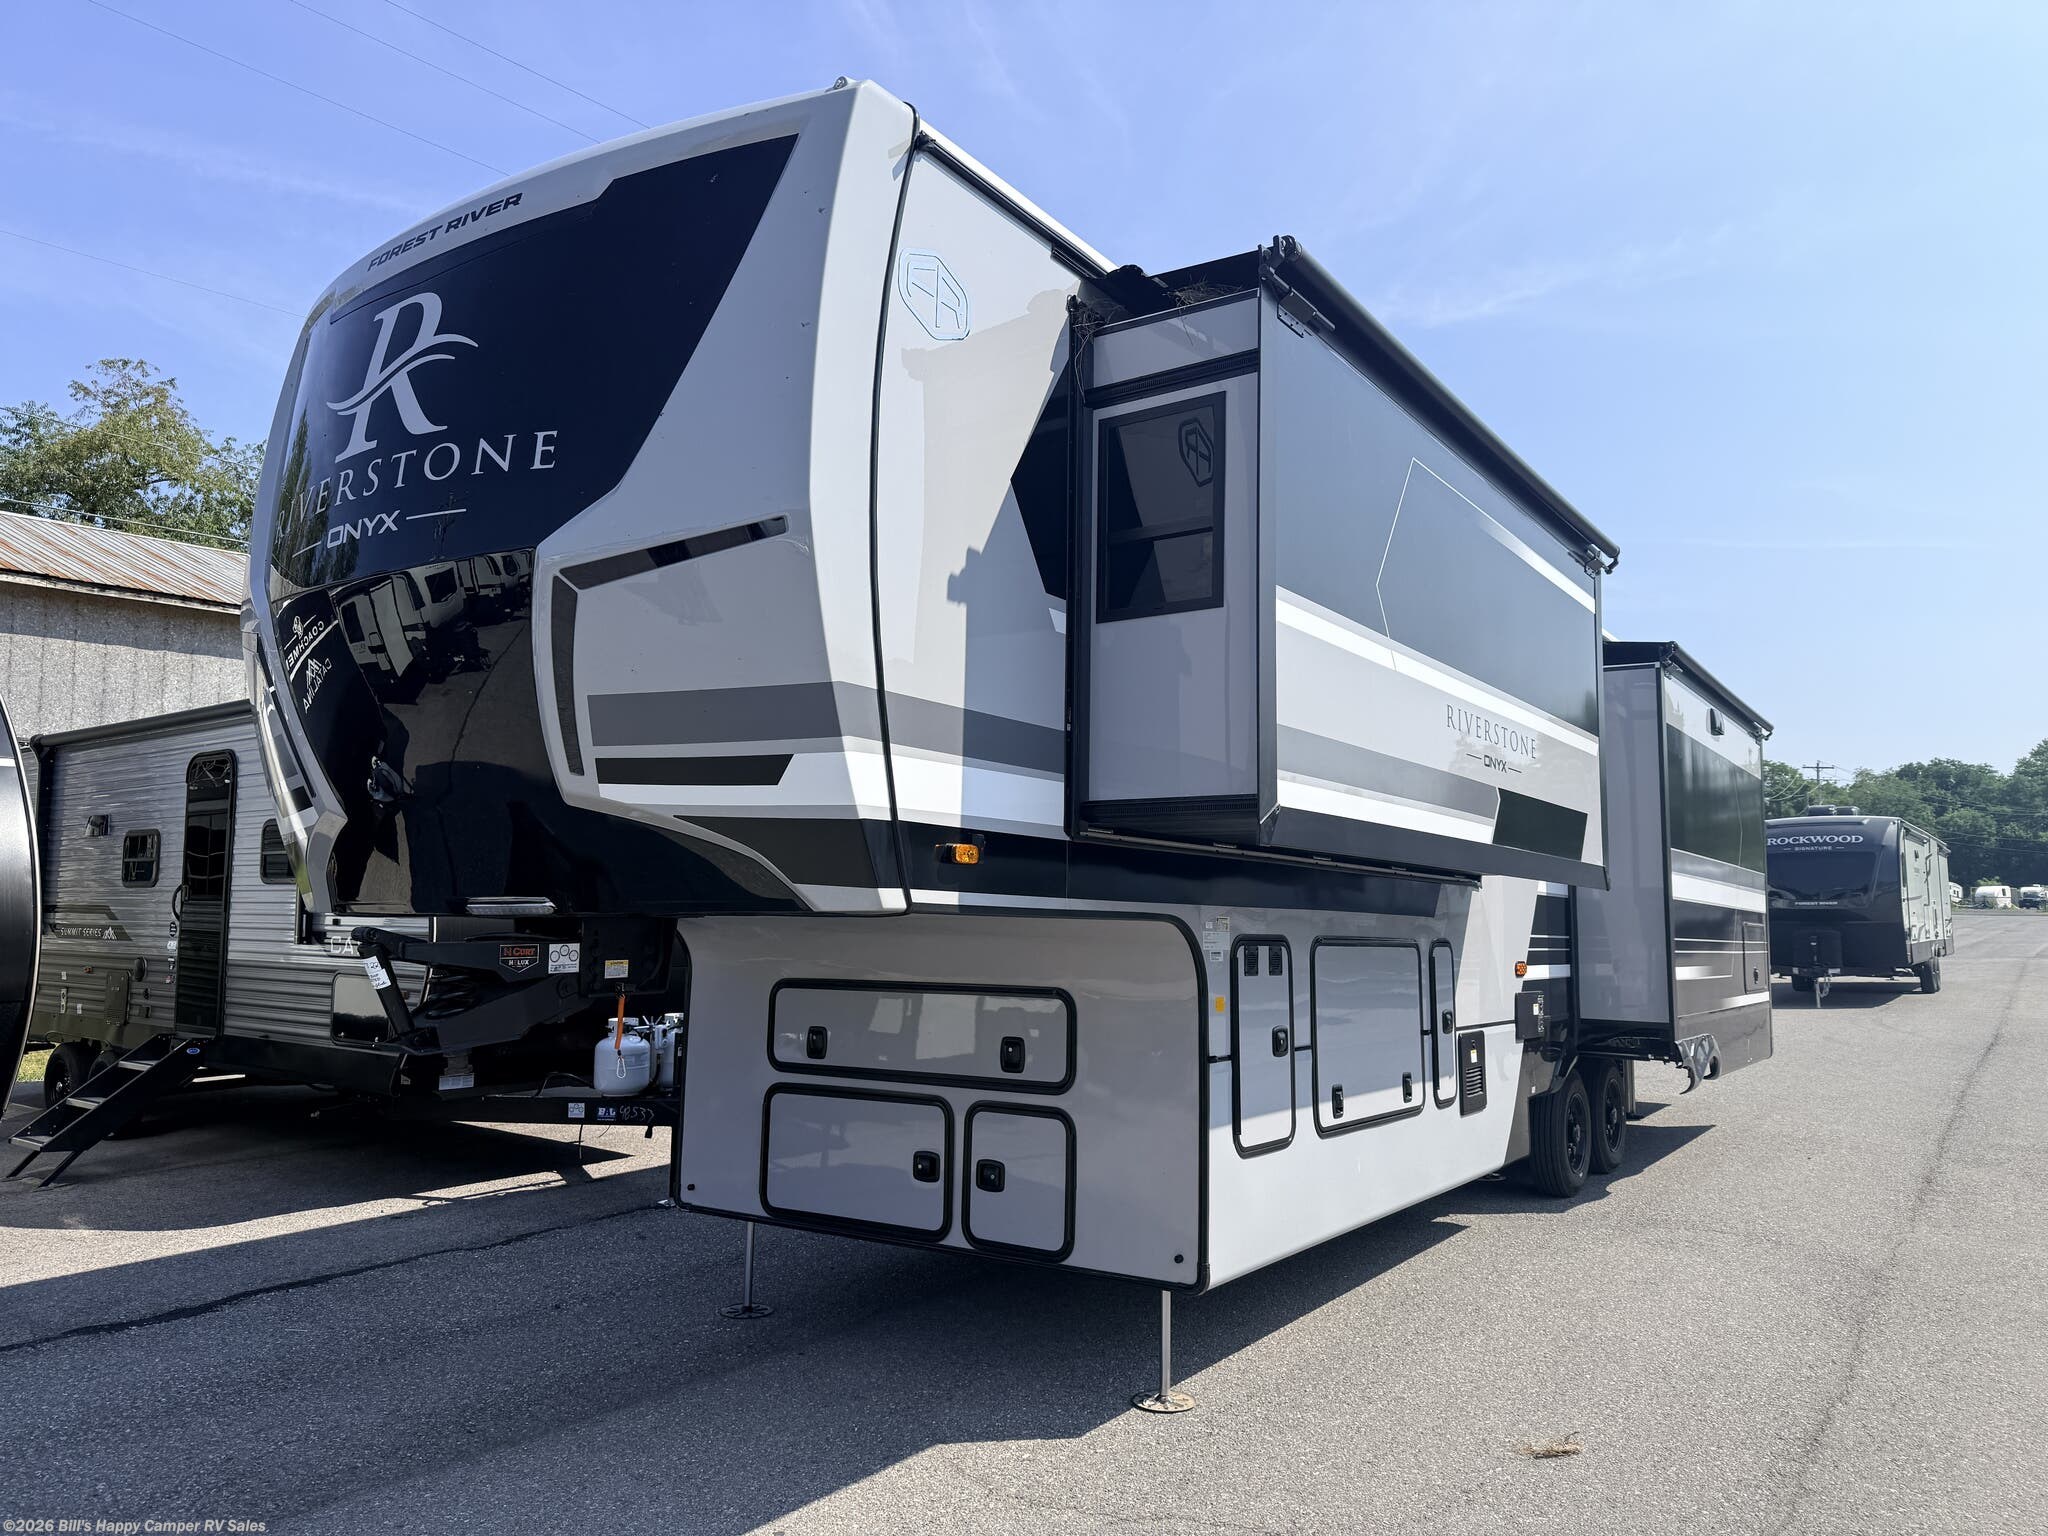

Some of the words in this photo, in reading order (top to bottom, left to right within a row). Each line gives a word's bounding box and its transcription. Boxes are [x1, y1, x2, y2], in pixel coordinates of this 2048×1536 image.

[367, 225, 443, 271] FOREST
[445, 193, 523, 233] RIVER
[274, 429, 558, 545] RIVERSTONE
[326, 509, 401, 549] ONYX
[1446, 704, 1537, 759] RIVERSTONE
[1483, 755, 1507, 773] ONYX
[1767, 834, 1864, 846] ROCKWOOD
[60, 927, 82, 937] SUMMIT
[82, 927, 102, 937] SERIES
